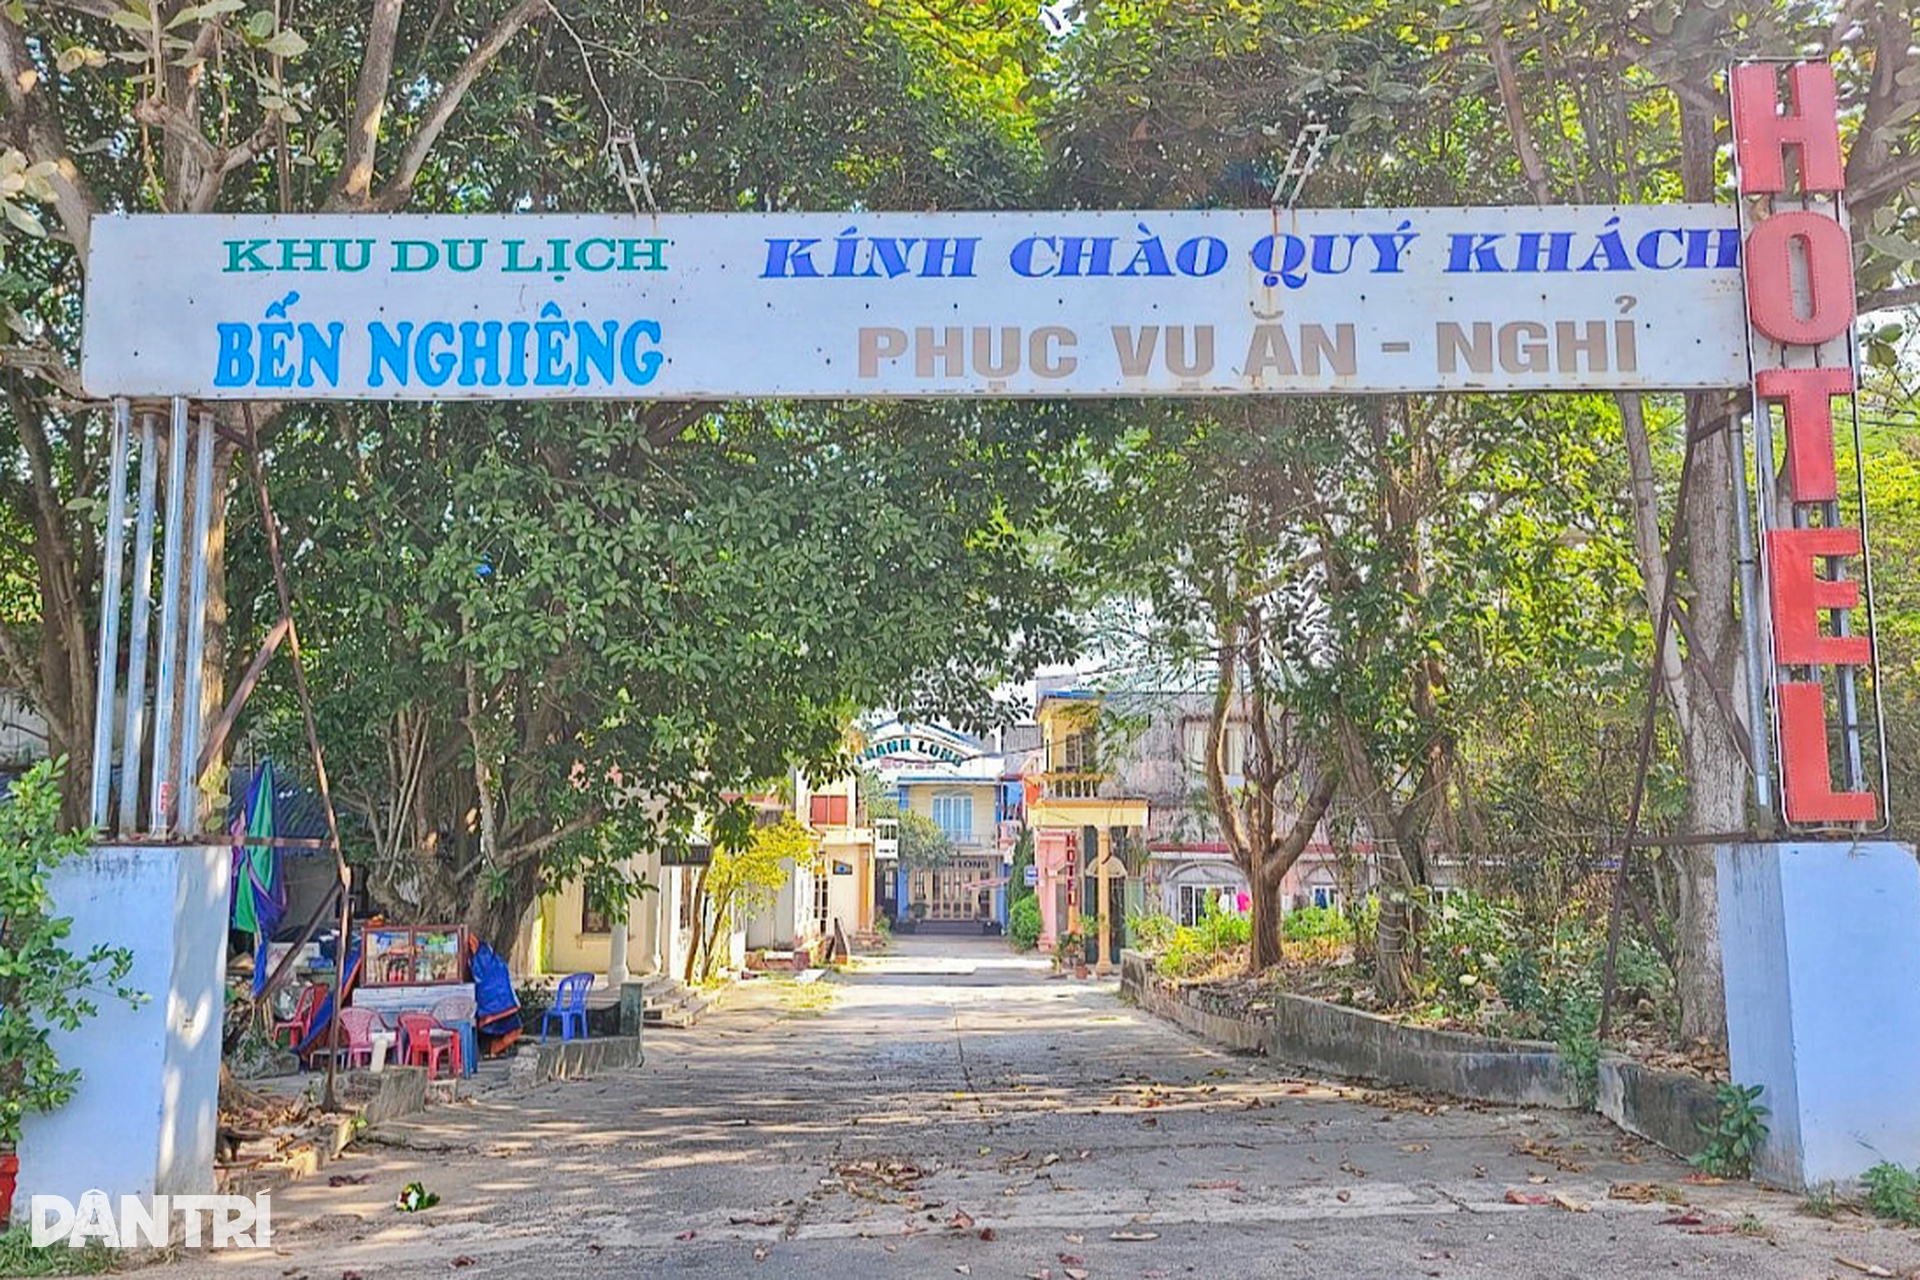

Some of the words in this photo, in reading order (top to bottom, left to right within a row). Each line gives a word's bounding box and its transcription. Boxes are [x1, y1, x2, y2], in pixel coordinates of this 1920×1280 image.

[222, 238, 376, 272] KHU
[391, 238, 487, 271] DU
[501, 238, 668, 283] LỊCH
[759, 226, 983, 279] KÍNH
[1009, 222, 1229, 277] CHÀO
[1252, 220, 1421, 289] QUÝ
[1442, 216, 1741, 273] KHÁCH
[215, 291, 344, 388] BẾN
[367, 301, 664, 388] NGHIÊNG
[857, 325, 1078, 389] PHỤC
[1110, 325, 1215, 388] VỤ
[1243, 306, 1358, 376] ĂN
[1435, 295, 1639, 374] NGHỈ
[1735, 61, 1876, 822] HOTEL
